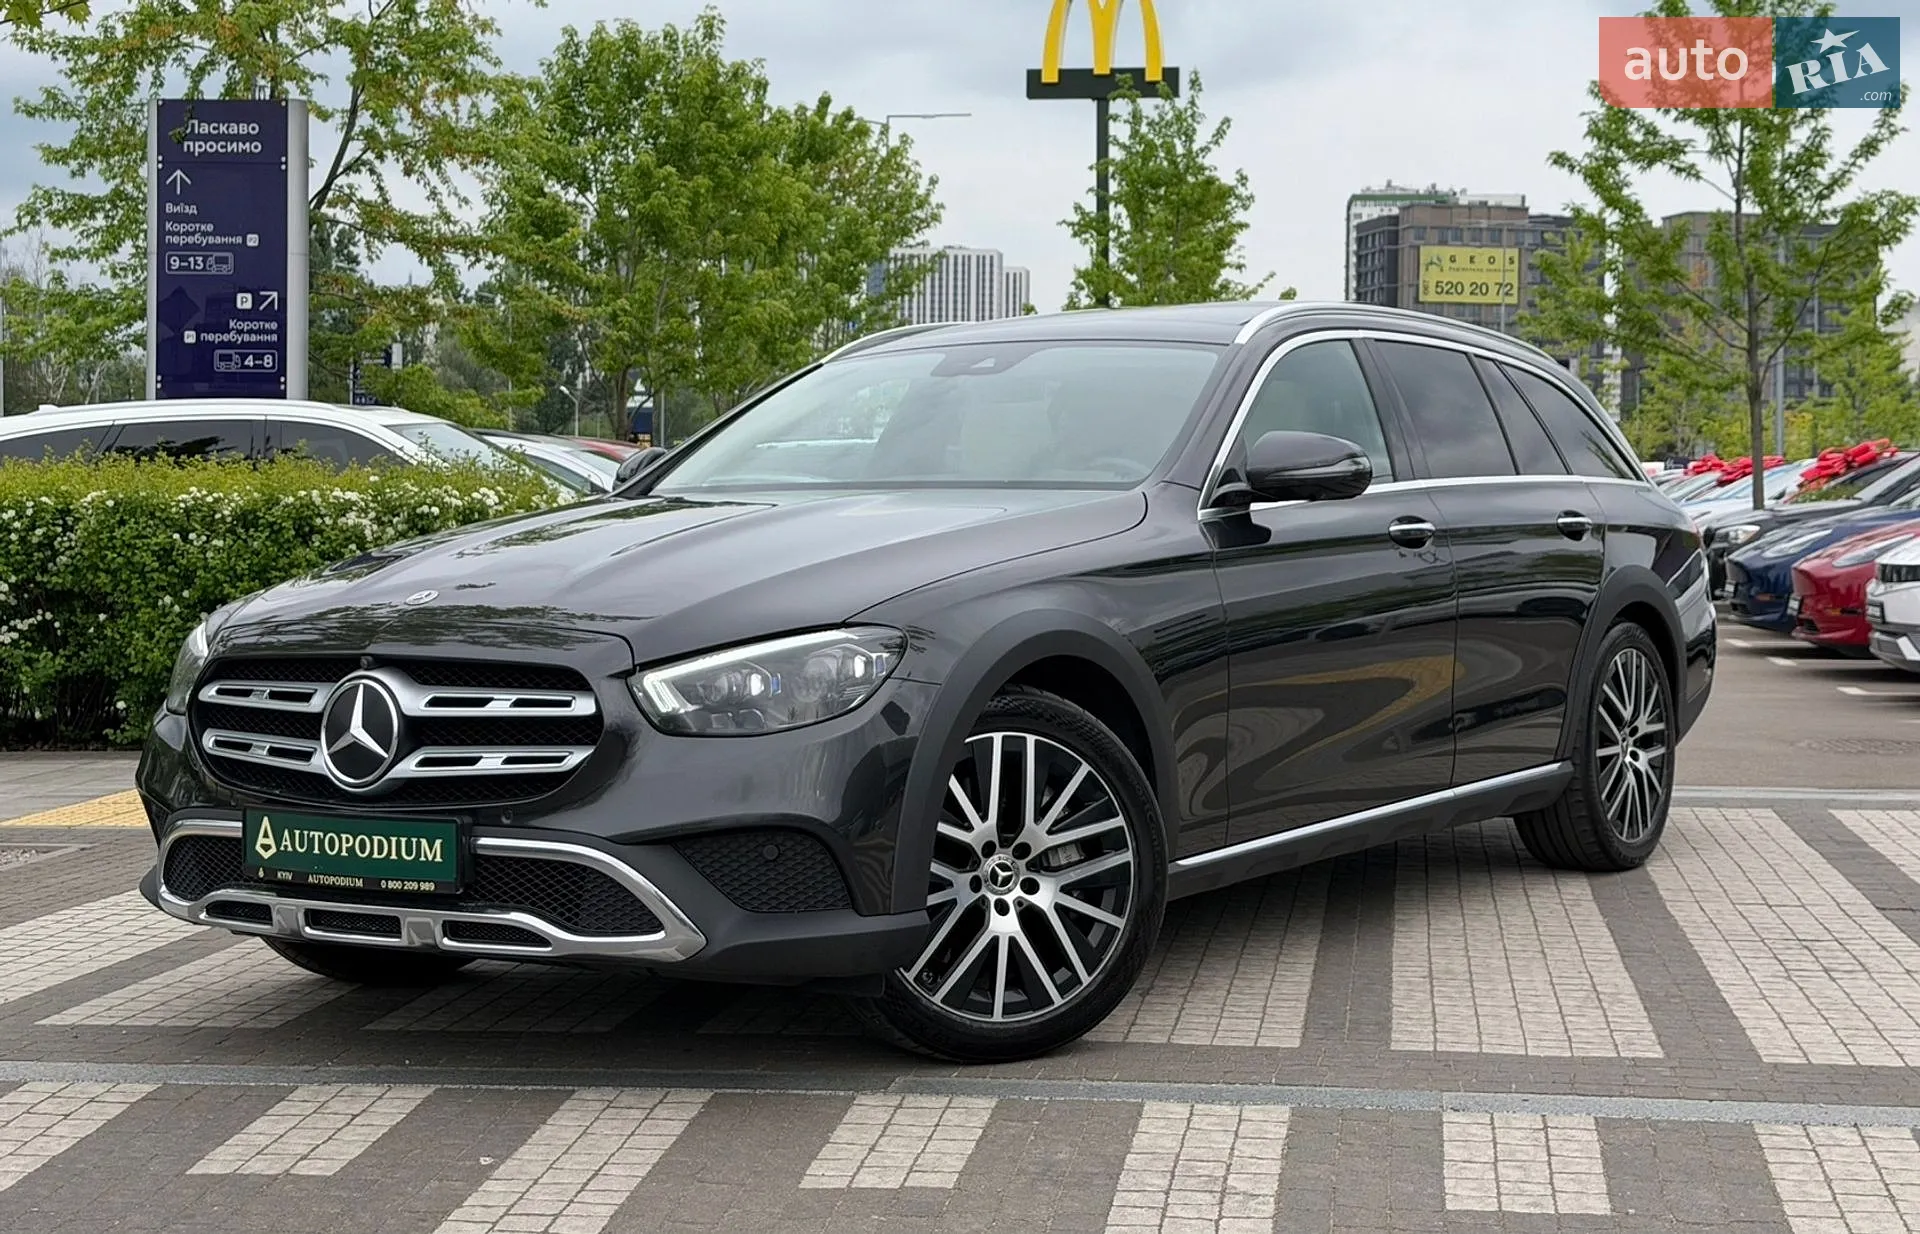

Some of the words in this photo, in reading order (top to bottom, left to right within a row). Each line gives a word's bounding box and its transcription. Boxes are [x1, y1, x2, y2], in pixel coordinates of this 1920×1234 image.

[186, 119, 260, 135] Ласкаво
[183, 140, 262, 156] просимо
[165, 203, 198, 215] Виїзд
[165, 221, 214, 233] Коротке
[165, 233, 243, 247] перебування
[1435, 281, 1464, 296] 520
[1469, 281, 1489, 297] 20
[1494, 281, 1514, 297] 72
[229, 319, 278, 331] Коротке
[200, 332, 278, 344] перебування
[279, 828, 444, 863] AUTOPODIUM
[277, 871, 293, 881] KYIV
[307, 873, 364, 888] AUTOPODIUM
[381, 879, 387, 889] 0
[387, 880, 403, 890] 800
[403, 880, 419, 891] 209
[419, 881, 435, 892] 989
